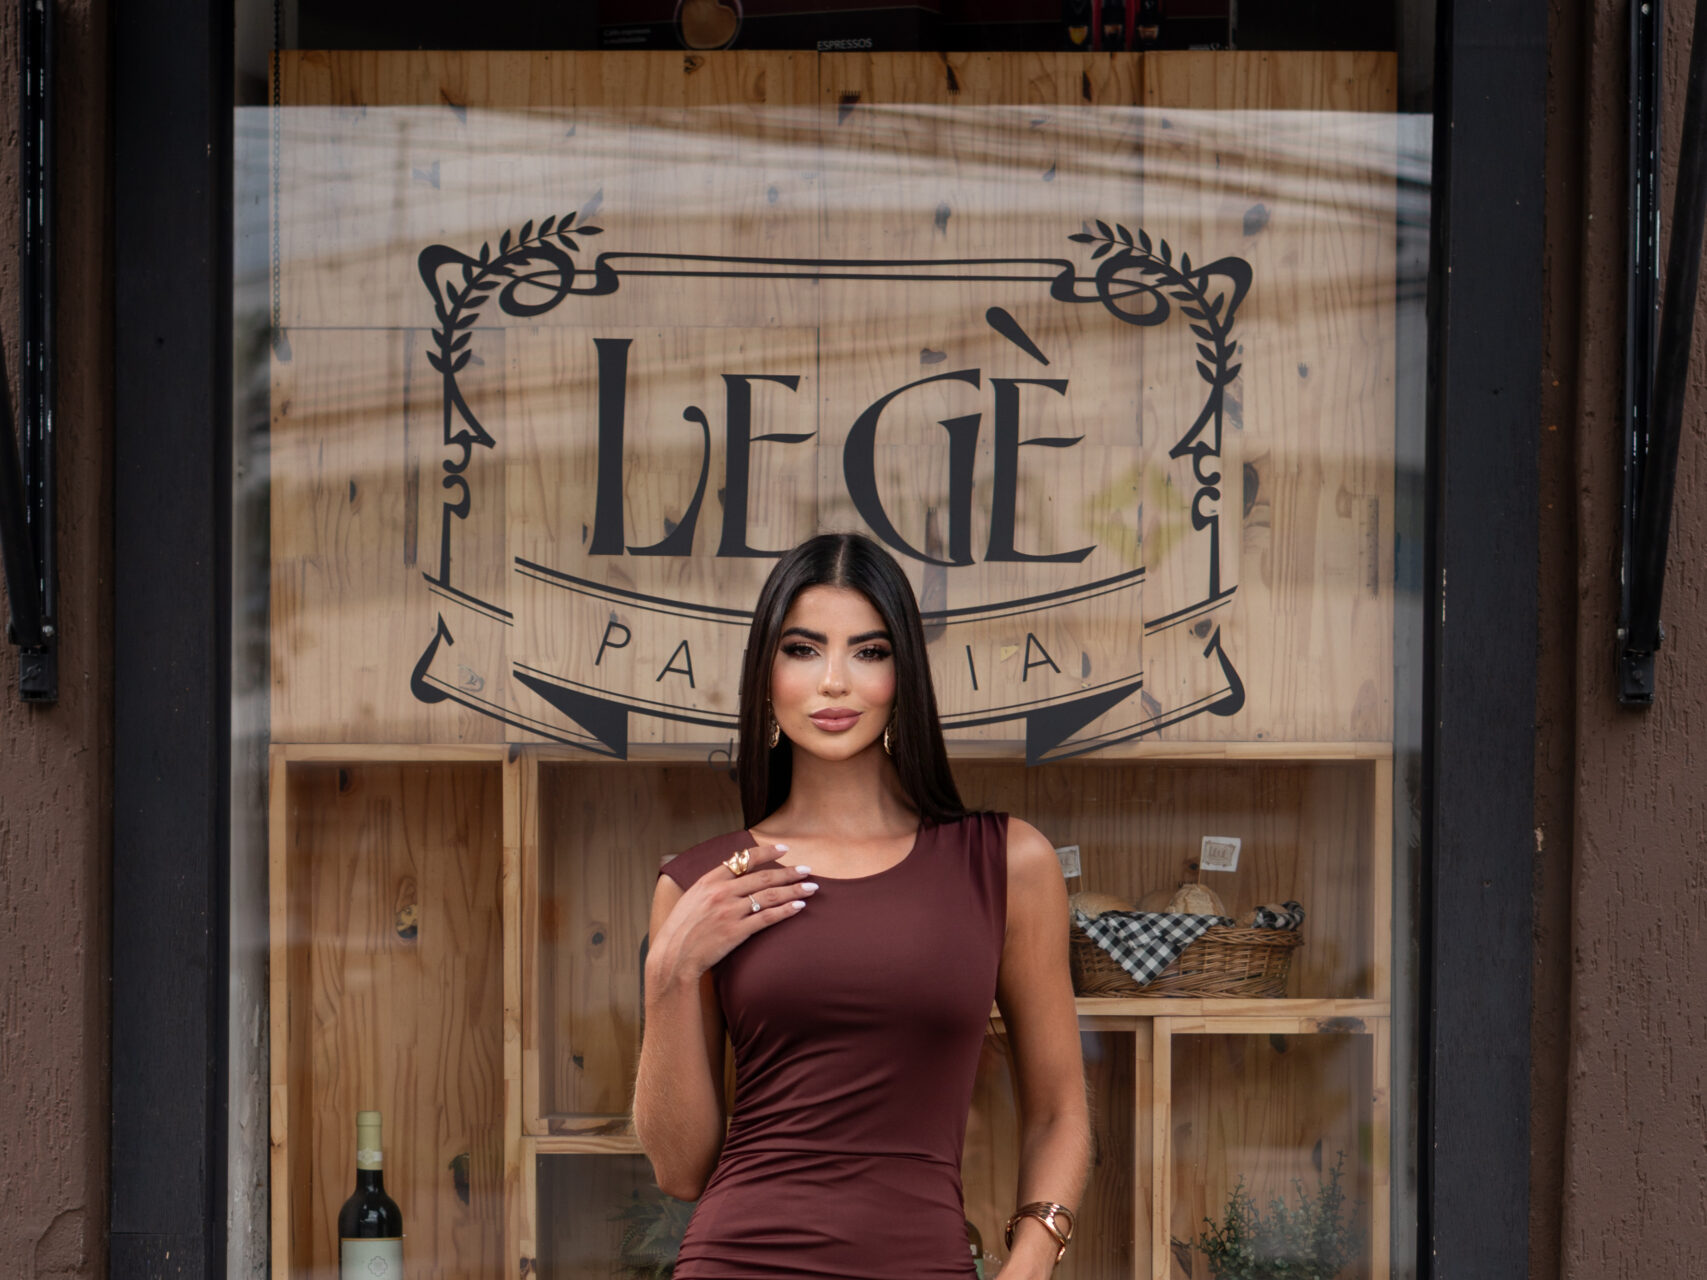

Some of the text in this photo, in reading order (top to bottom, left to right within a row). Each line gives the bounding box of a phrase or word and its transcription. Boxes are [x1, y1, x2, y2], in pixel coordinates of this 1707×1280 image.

[816, 37, 873, 51] ESPRESSOS
[588, 306, 1098, 568] LEGÈ
[594, 621, 1061, 696] PAIA
